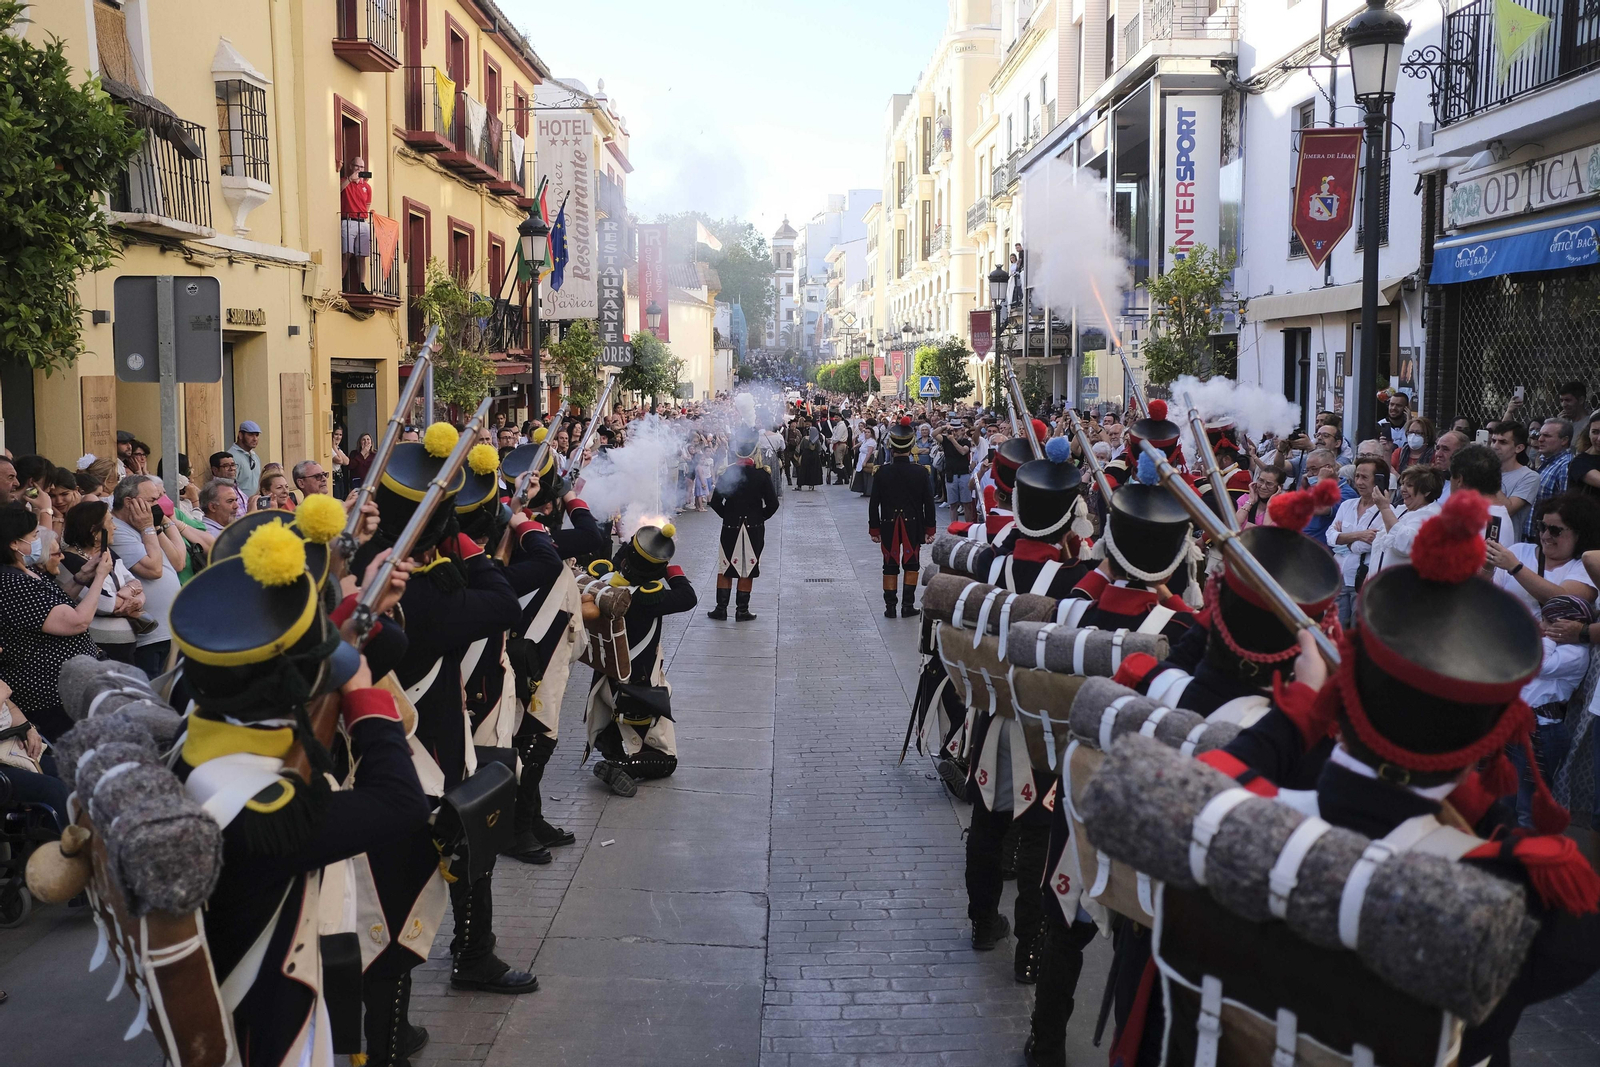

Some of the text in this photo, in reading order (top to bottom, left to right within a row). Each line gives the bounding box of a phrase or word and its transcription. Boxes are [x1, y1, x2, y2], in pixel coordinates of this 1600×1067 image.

[539, 120, 591, 137] HOTEL
[1175, 107, 1196, 253] INTERSPORT
[1484, 154, 1586, 215] OPTICA
[570, 149, 591, 282] Restaurante
[602, 221, 619, 343] RESTAURANTE
[545, 290, 595, 316] Javier
[558, 288, 575, 298] Don
[1031, 336, 1067, 344] Cafería
[597, 346, 631, 362] ORES
[978, 769, 988, 786] 3
[1021, 783, 1033, 801] 4
[1056, 874, 1071, 896] 3
